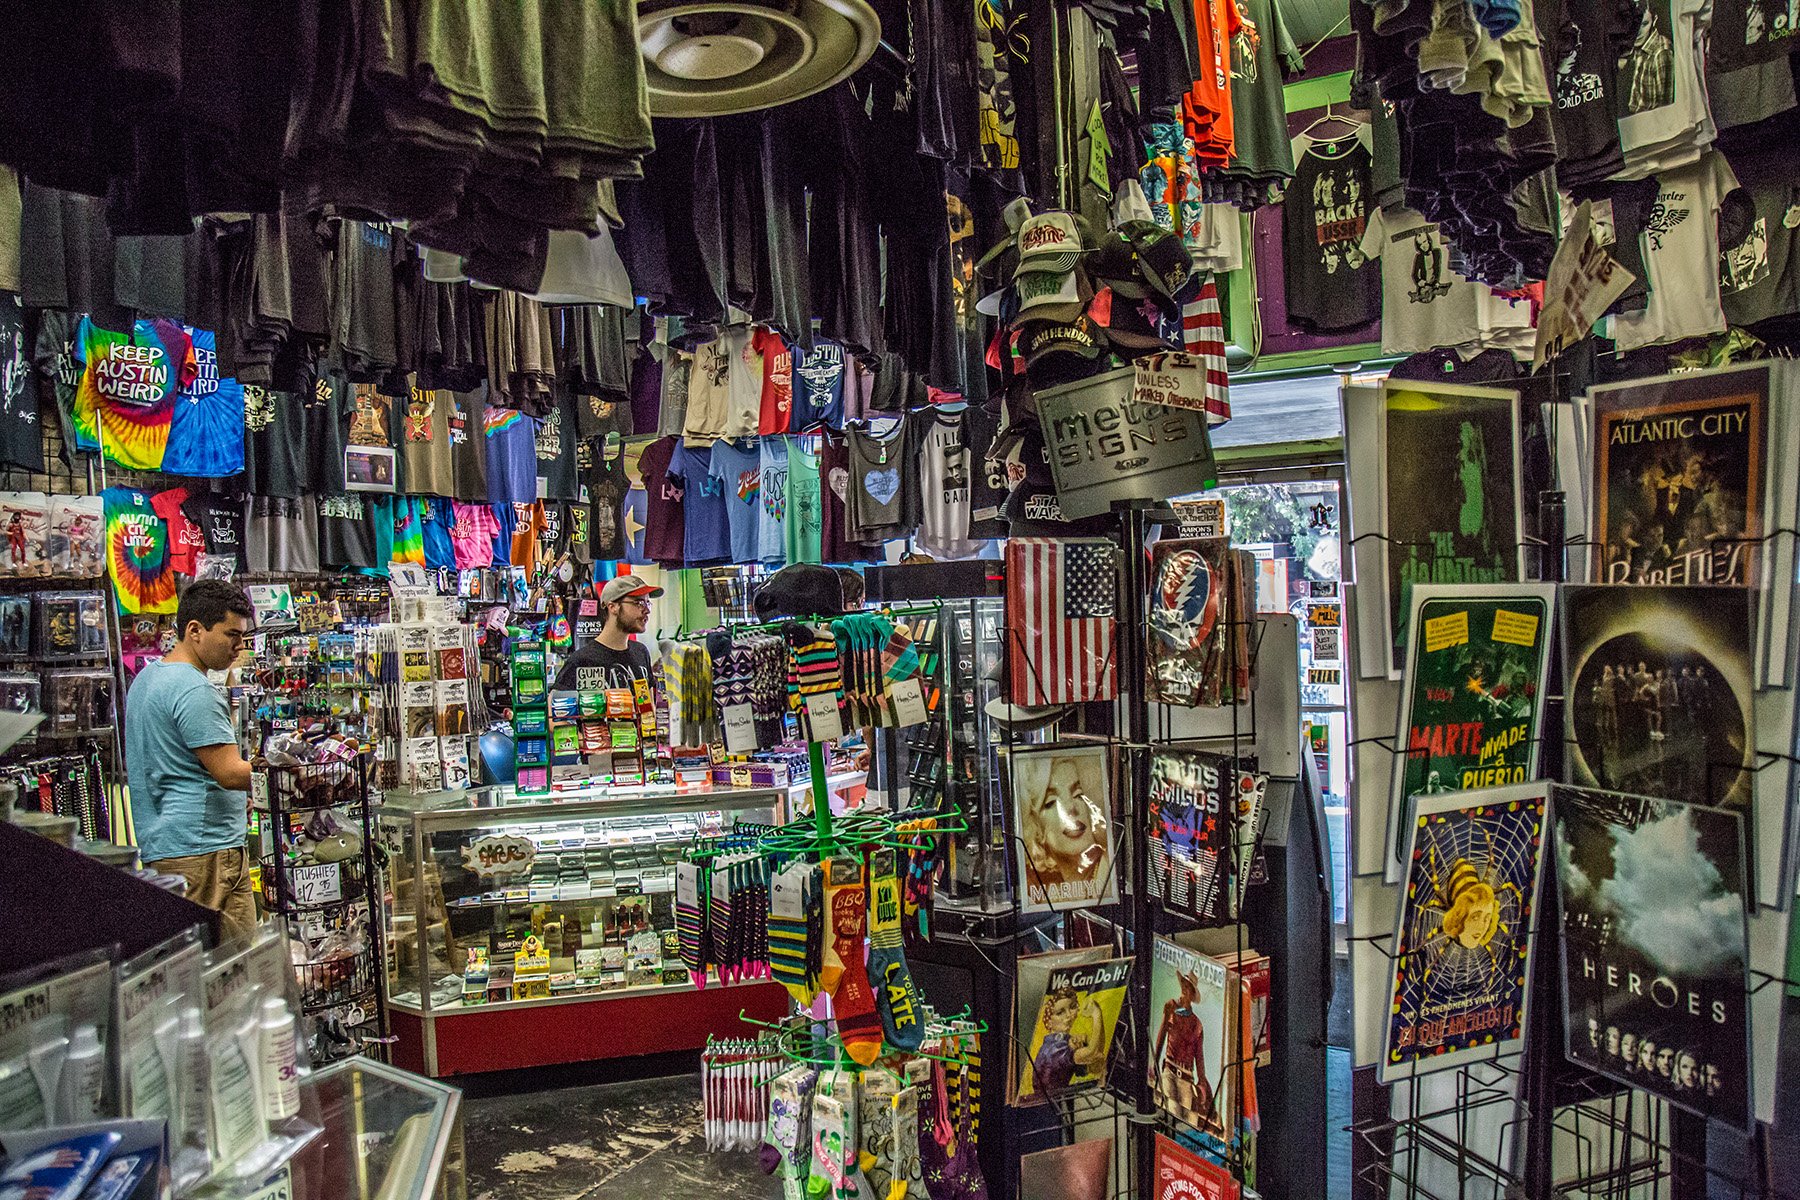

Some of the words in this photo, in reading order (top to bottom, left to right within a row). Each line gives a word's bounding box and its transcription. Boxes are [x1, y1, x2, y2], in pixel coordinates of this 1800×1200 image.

[1557, 95, 1582, 110] ORLD
[1582, 86, 1604, 103] TOUR
[1314, 203, 1357, 226] BACK
[1050, 325, 1094, 347] HENDRIX
[109, 341, 164, 364] KEEP
[95, 358, 168, 385] AUSTIN
[1137, 372, 1180, 391] UNLESS
[97, 377, 165, 402] WEIRD
[1134, 387, 1165, 404] MARKED
[1167, 390, 1205, 410] OTHERWISE
[1610, 417, 1695, 445] ATLANTIC
[1700, 410, 1748, 436] CITY
[1058, 416, 1188, 469] SIGNS
[1025, 494, 1060, 508] STA
[1181, 525, 1212, 533] AARON'S
[577, 667, 605, 679] GUM!
[577, 680, 604, 690] $1.50
[1407, 721, 1484, 759] MARTE
[1479, 723, 1528, 766] INVADE
[1494, 753, 1506, 766] a
[1150, 776, 1221, 815] AMIGOS
[295, 865, 336, 881] PLUSHIES
[835, 891, 865, 909] BBQ
[1155, 939, 1184, 969] JOHN
[1184, 953, 1225, 988] WAYNE
[1052, 973, 1070, 990] We
[1070, 970, 1094, 988] Can
[1096, 968, 1111, 984] Do
[1111, 965, 1128, 981] It!
[884, 961, 917, 1031] LATE
[1582, 957, 1727, 1024] HEROES
